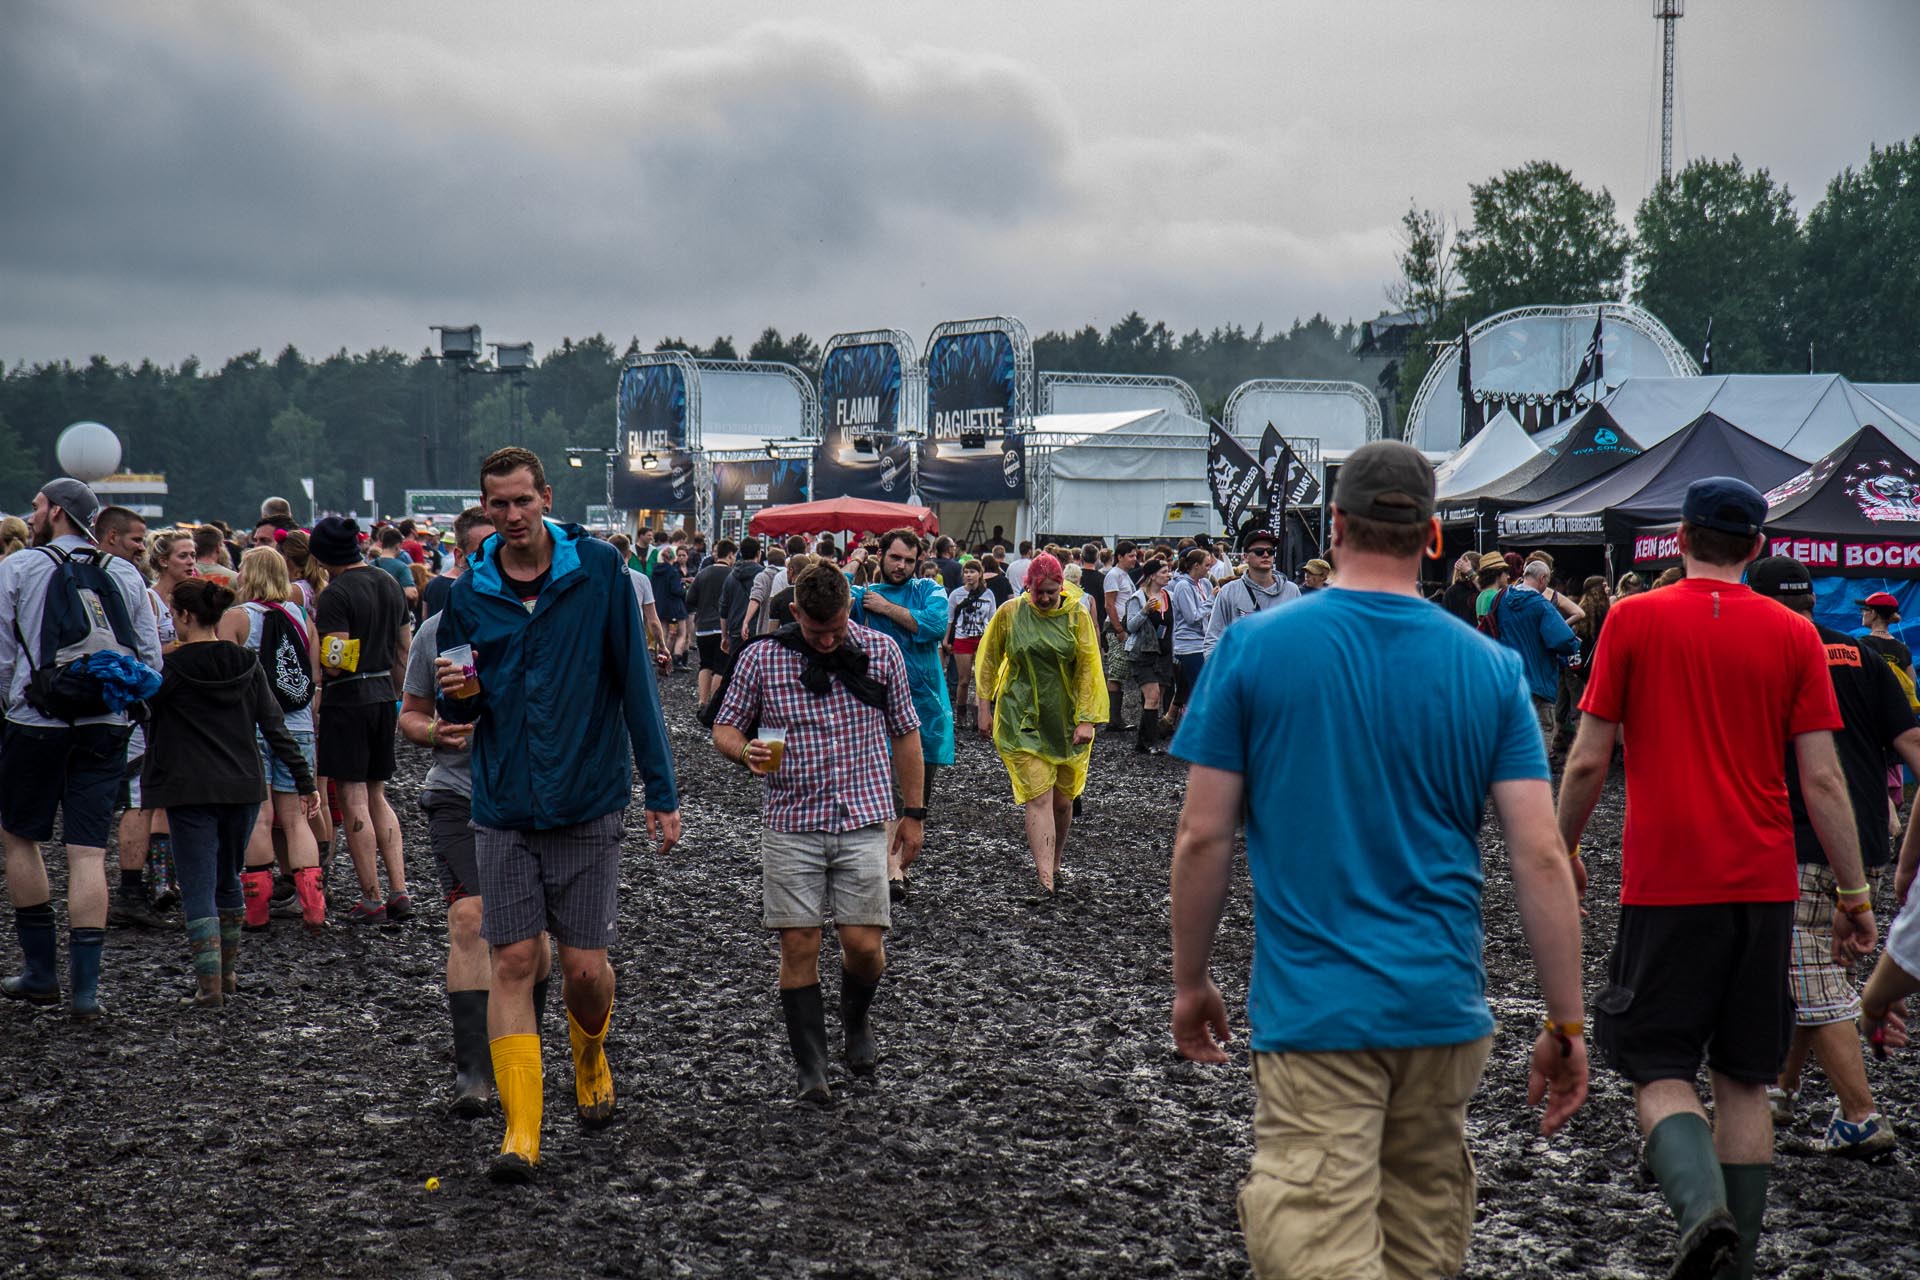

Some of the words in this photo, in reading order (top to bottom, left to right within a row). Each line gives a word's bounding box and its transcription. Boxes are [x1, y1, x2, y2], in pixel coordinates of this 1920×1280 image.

[836, 396, 879, 426] FLAMM
[935, 407, 1005, 440] BAGUETTE
[1572, 448, 1594, 456] VIVA
[1554, 517, 1566, 533] FÜR
[1634, 536, 1658, 560] KEIN
[1771, 541, 1838, 563] KEIN
[1845, 546, 1920, 567] BOCK
[1827, 648, 1858, 661] ULTRAS
